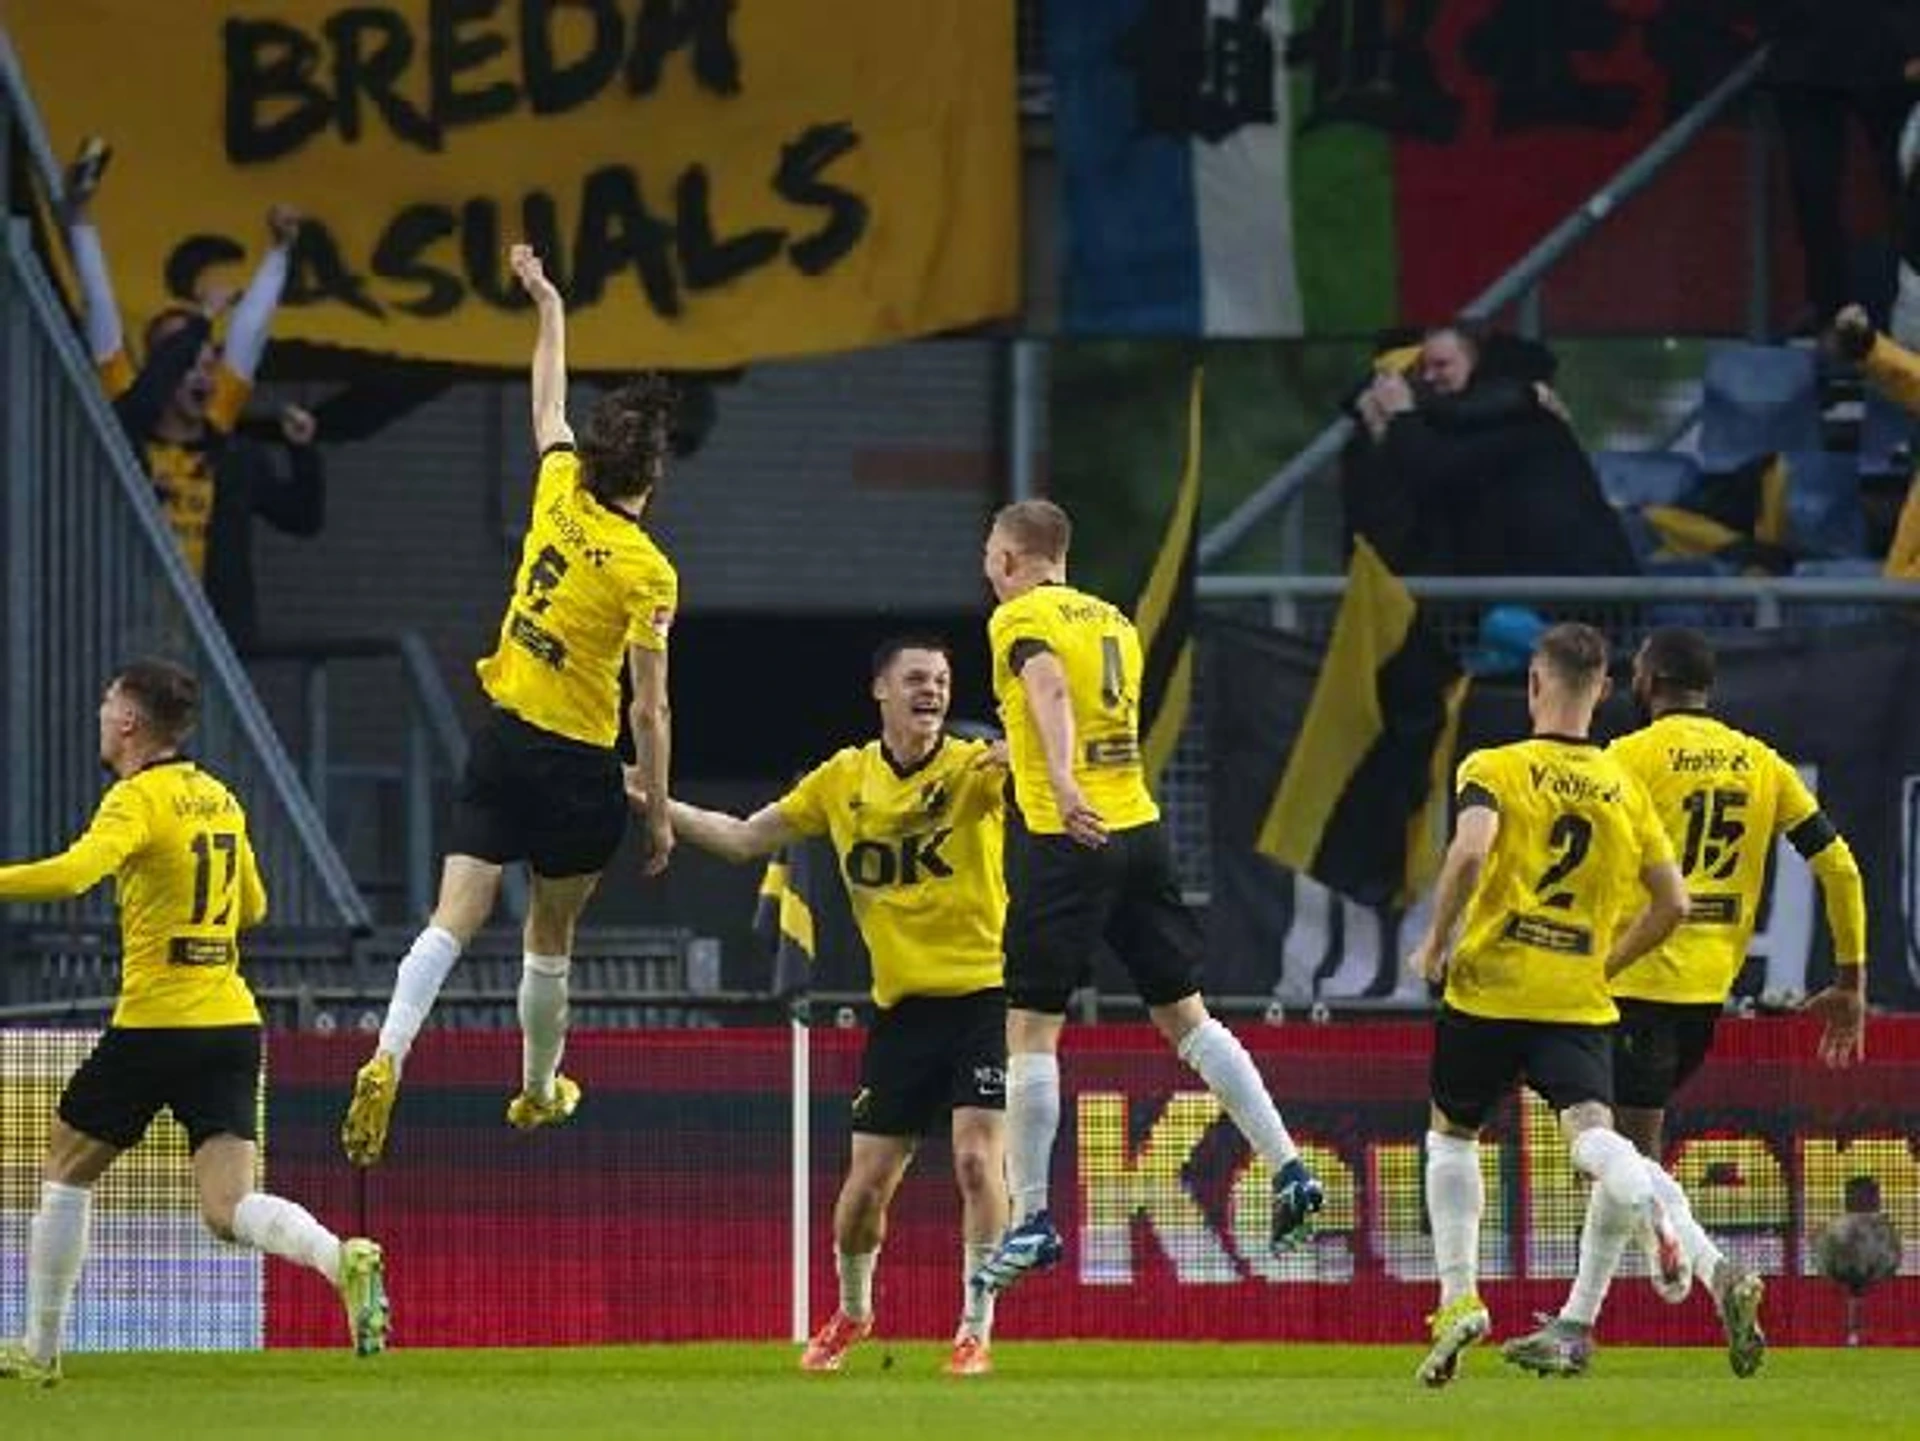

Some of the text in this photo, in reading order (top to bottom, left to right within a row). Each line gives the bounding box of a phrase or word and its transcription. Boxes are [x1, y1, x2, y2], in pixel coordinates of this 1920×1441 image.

[221, 0, 742, 165] BREDA
[190, 831, 237, 925] 17
[846, 825, 955, 887] OK
[1535, 813, 1594, 910] 2
[1681, 787, 1750, 880] 15
